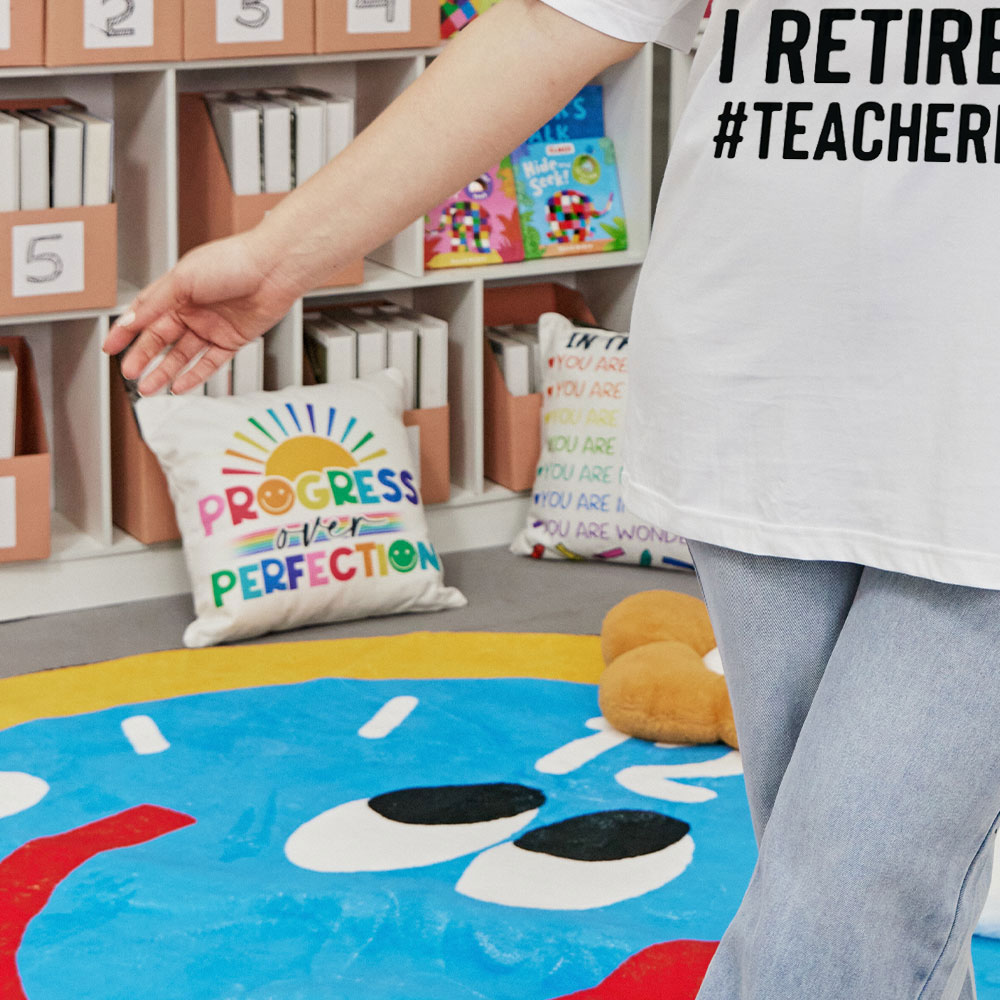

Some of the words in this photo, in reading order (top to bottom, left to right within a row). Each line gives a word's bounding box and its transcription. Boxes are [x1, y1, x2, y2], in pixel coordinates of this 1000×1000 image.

[719, 8, 740, 84] I
[26, 233, 64, 283] 5
[566, 332, 598, 349] IN
[555, 355, 591, 370] YOU
[594, 356, 628, 372] ARE
[554, 380, 586, 398] YOU
[590, 381, 625, 399] ARE
[586, 409, 619, 427] ARE
[583, 436, 616, 455] ARE
[543, 464, 574, 481] YOU
[579, 465, 612, 484] ARE
[198, 468, 419, 536] PROGRESS
[540, 491, 572, 509] YOU
[577, 492, 610, 512] ARE
[276, 516, 388, 549] over
[576, 520, 610, 540] ARE
[211, 539, 440, 608] PERFECTION
